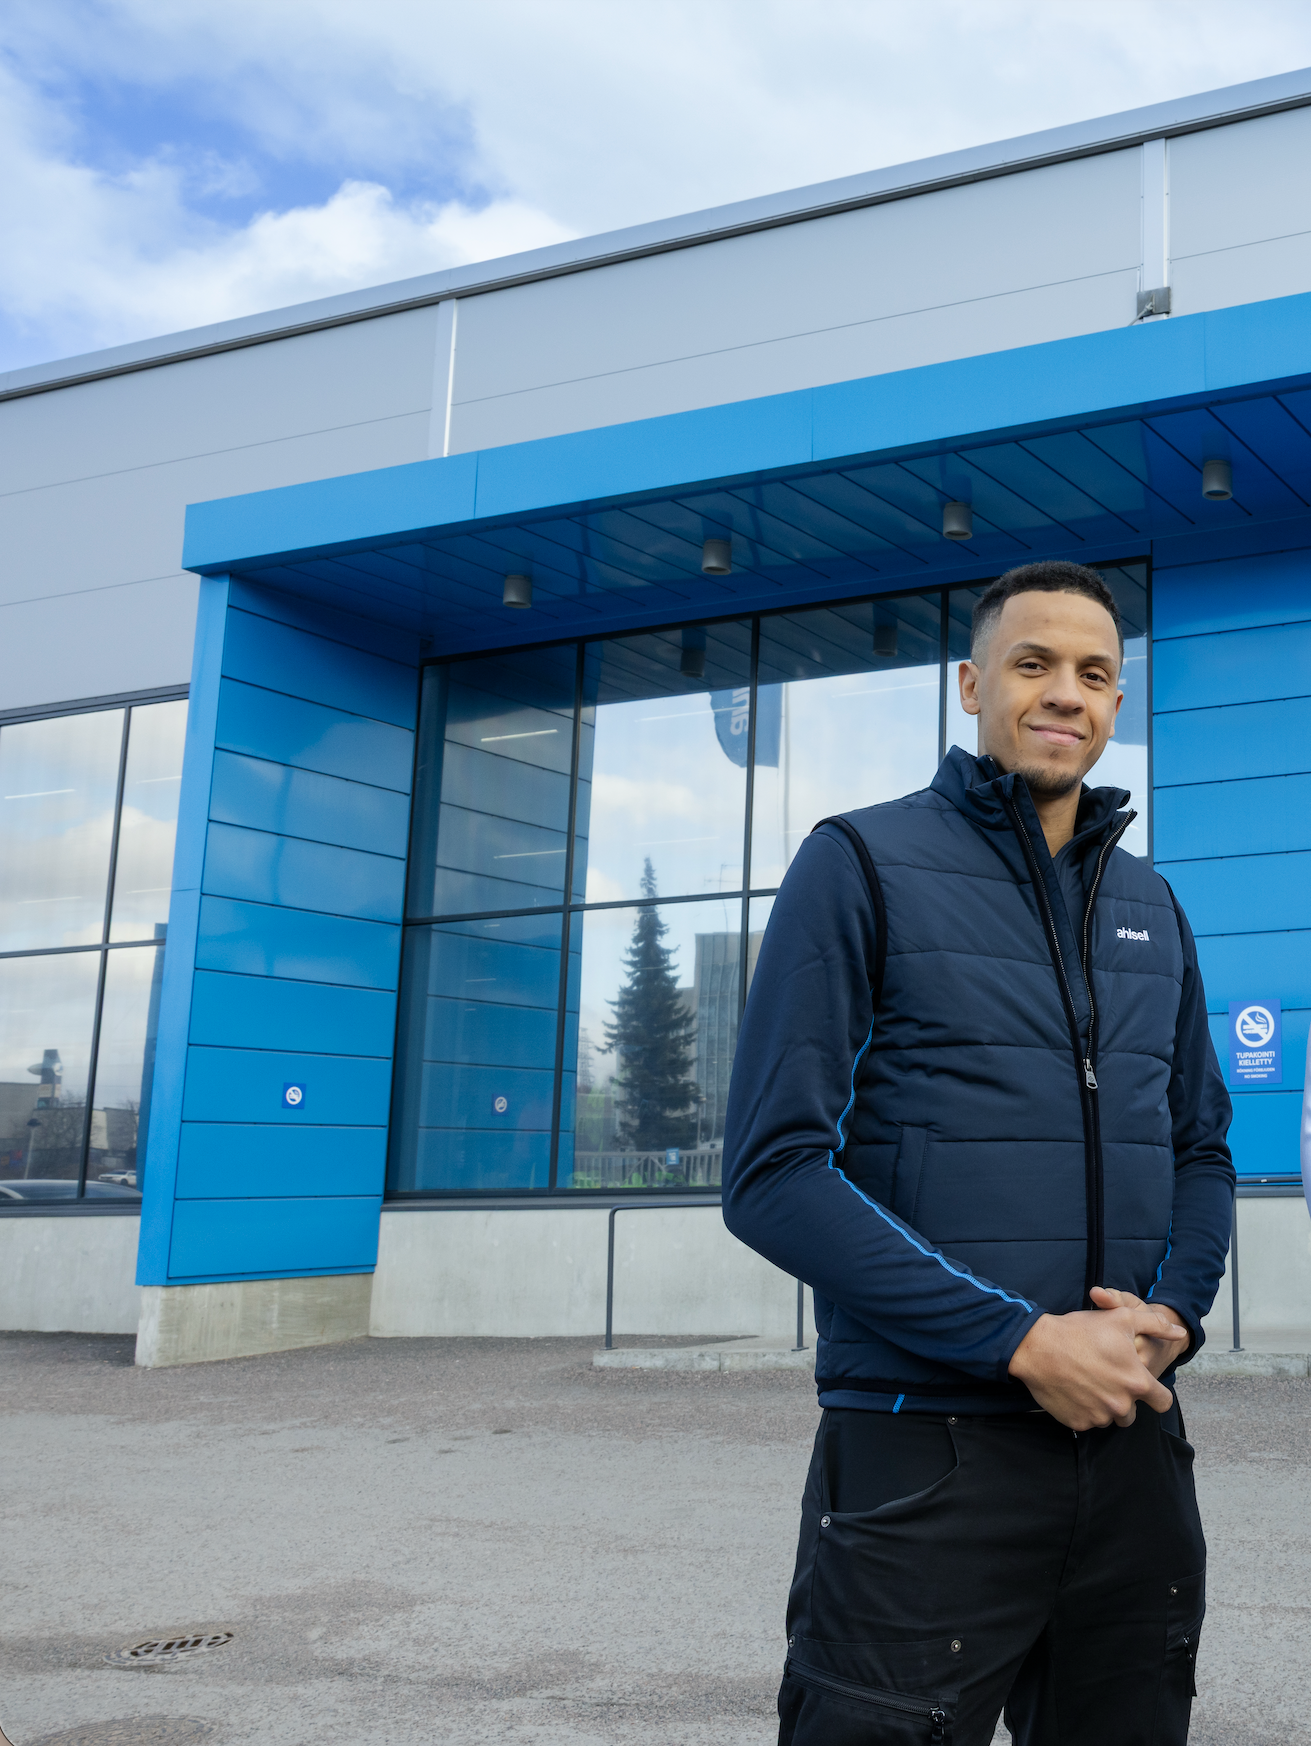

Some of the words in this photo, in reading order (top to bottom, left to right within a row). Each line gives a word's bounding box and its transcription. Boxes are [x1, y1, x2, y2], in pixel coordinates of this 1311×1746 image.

[1116, 926, 1150, 941] ahlsell
[1236, 1051, 1275, 1059] TUPAKOINTI
[1238, 1058, 1273, 1066] KIELLETTY
